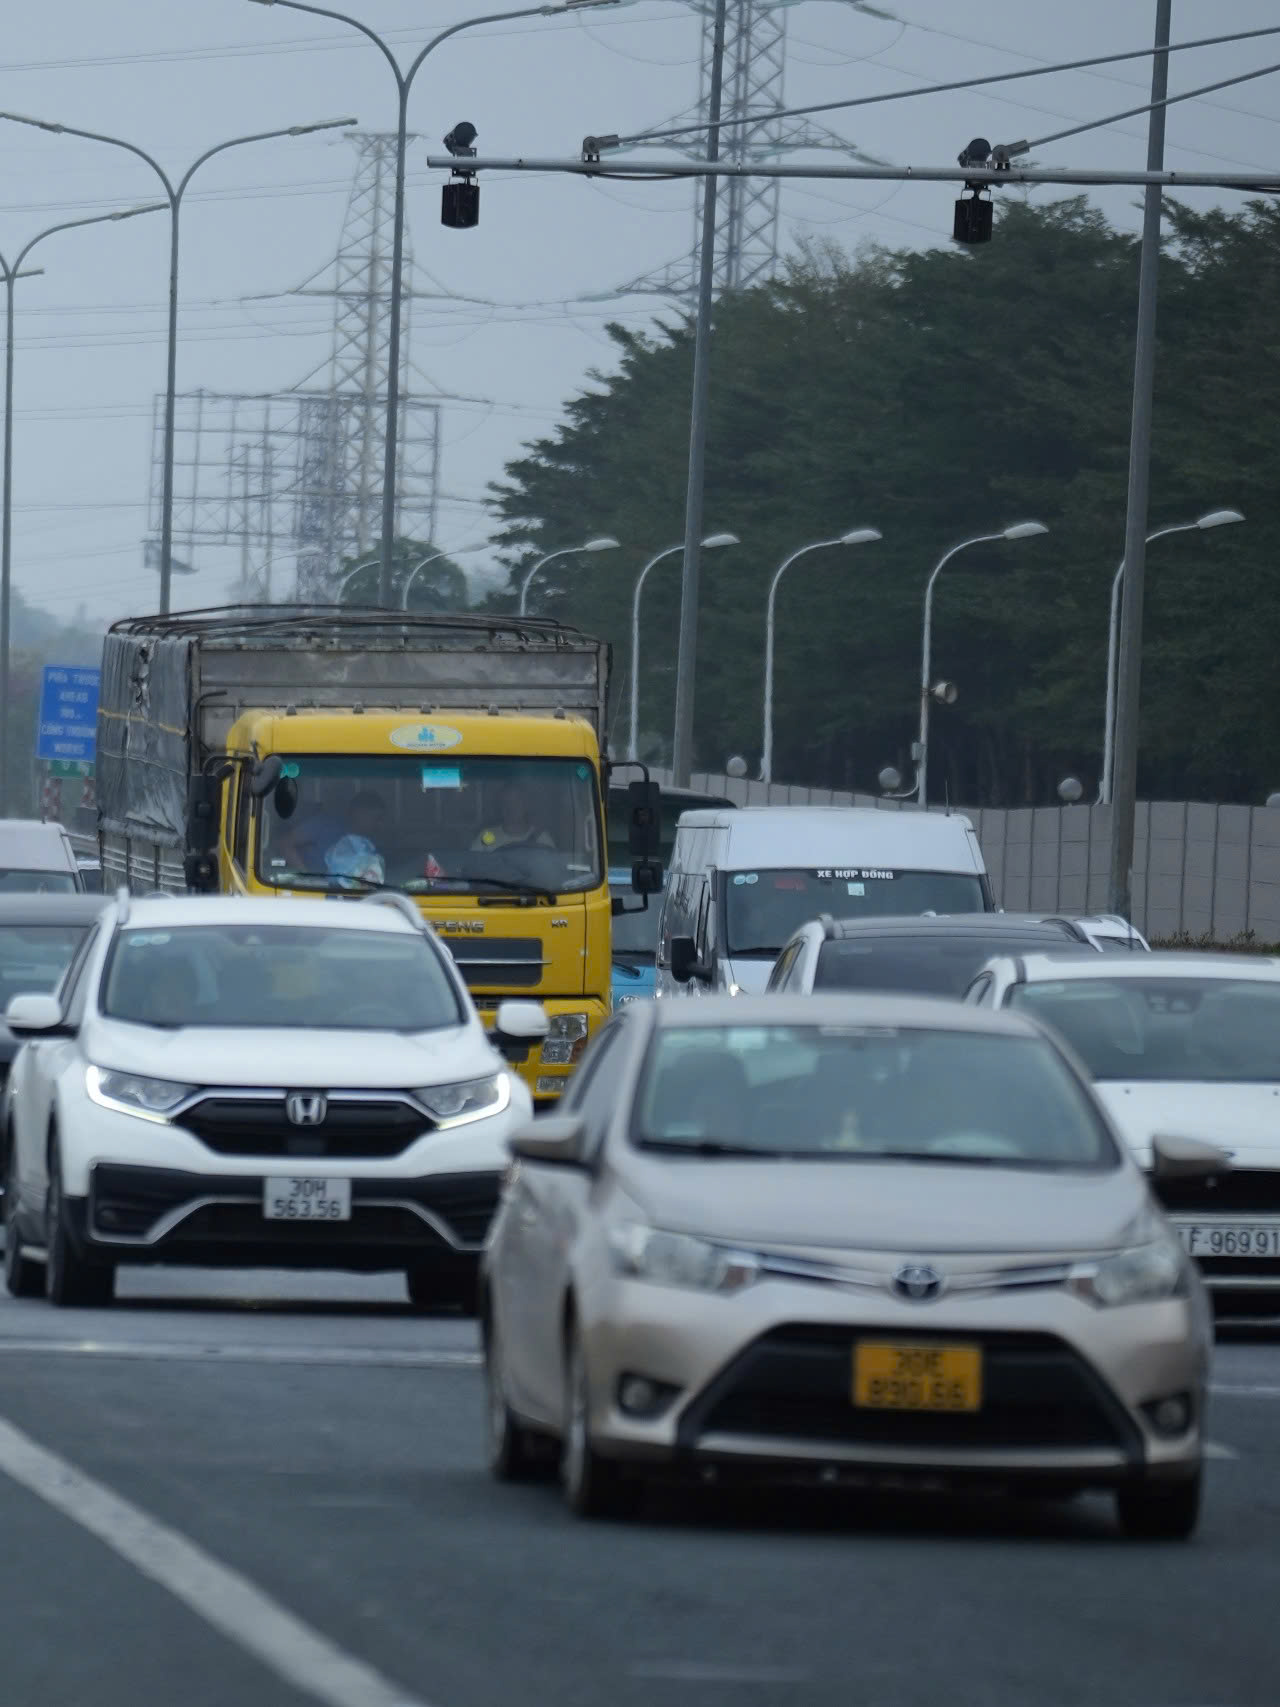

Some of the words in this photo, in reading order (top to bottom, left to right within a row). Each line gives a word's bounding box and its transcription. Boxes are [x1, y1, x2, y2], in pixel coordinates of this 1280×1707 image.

[817, 870, 832, 878] XE
[835, 870, 858, 880] HỢP
[862, 870, 894, 880] ĐỒNG
